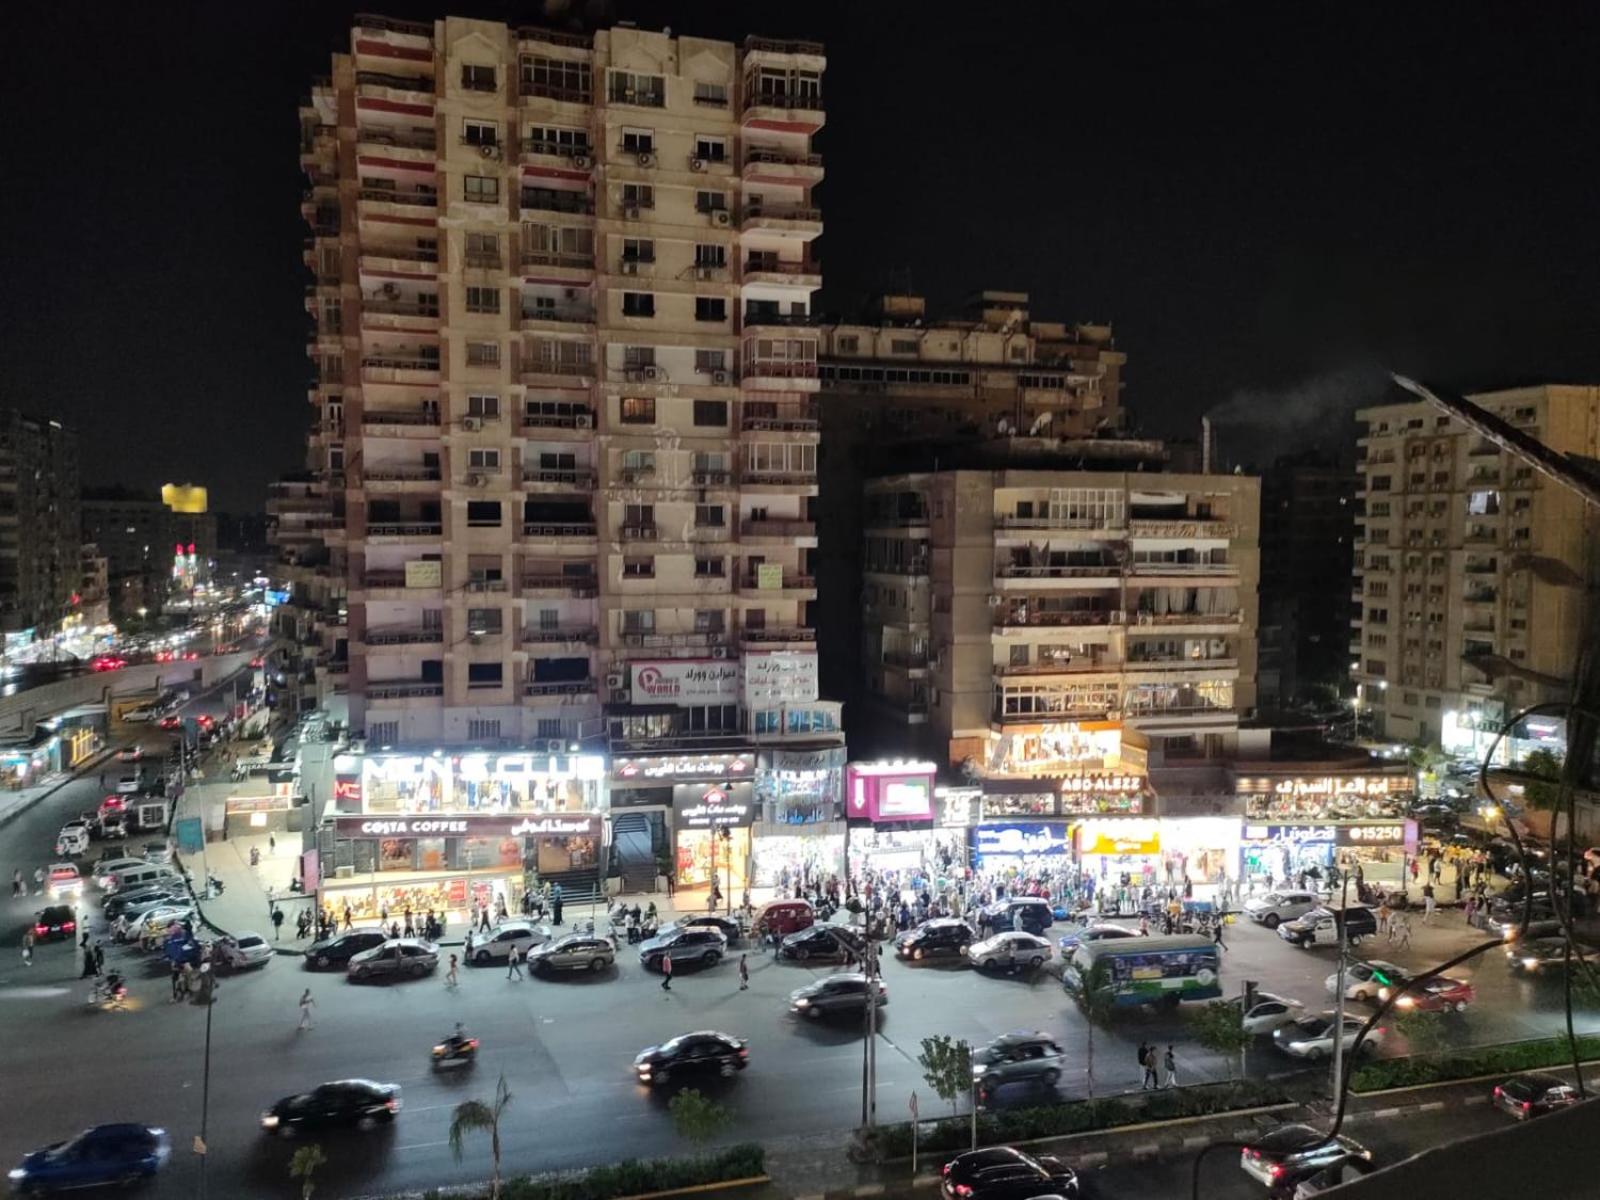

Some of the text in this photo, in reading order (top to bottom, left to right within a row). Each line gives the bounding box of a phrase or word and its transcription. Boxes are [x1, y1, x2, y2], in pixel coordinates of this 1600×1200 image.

[497, 755, 606, 779] CLUB
[362, 821, 467, 833] COSTA COFFEE
[1361, 826, 1402, 840] 15250
